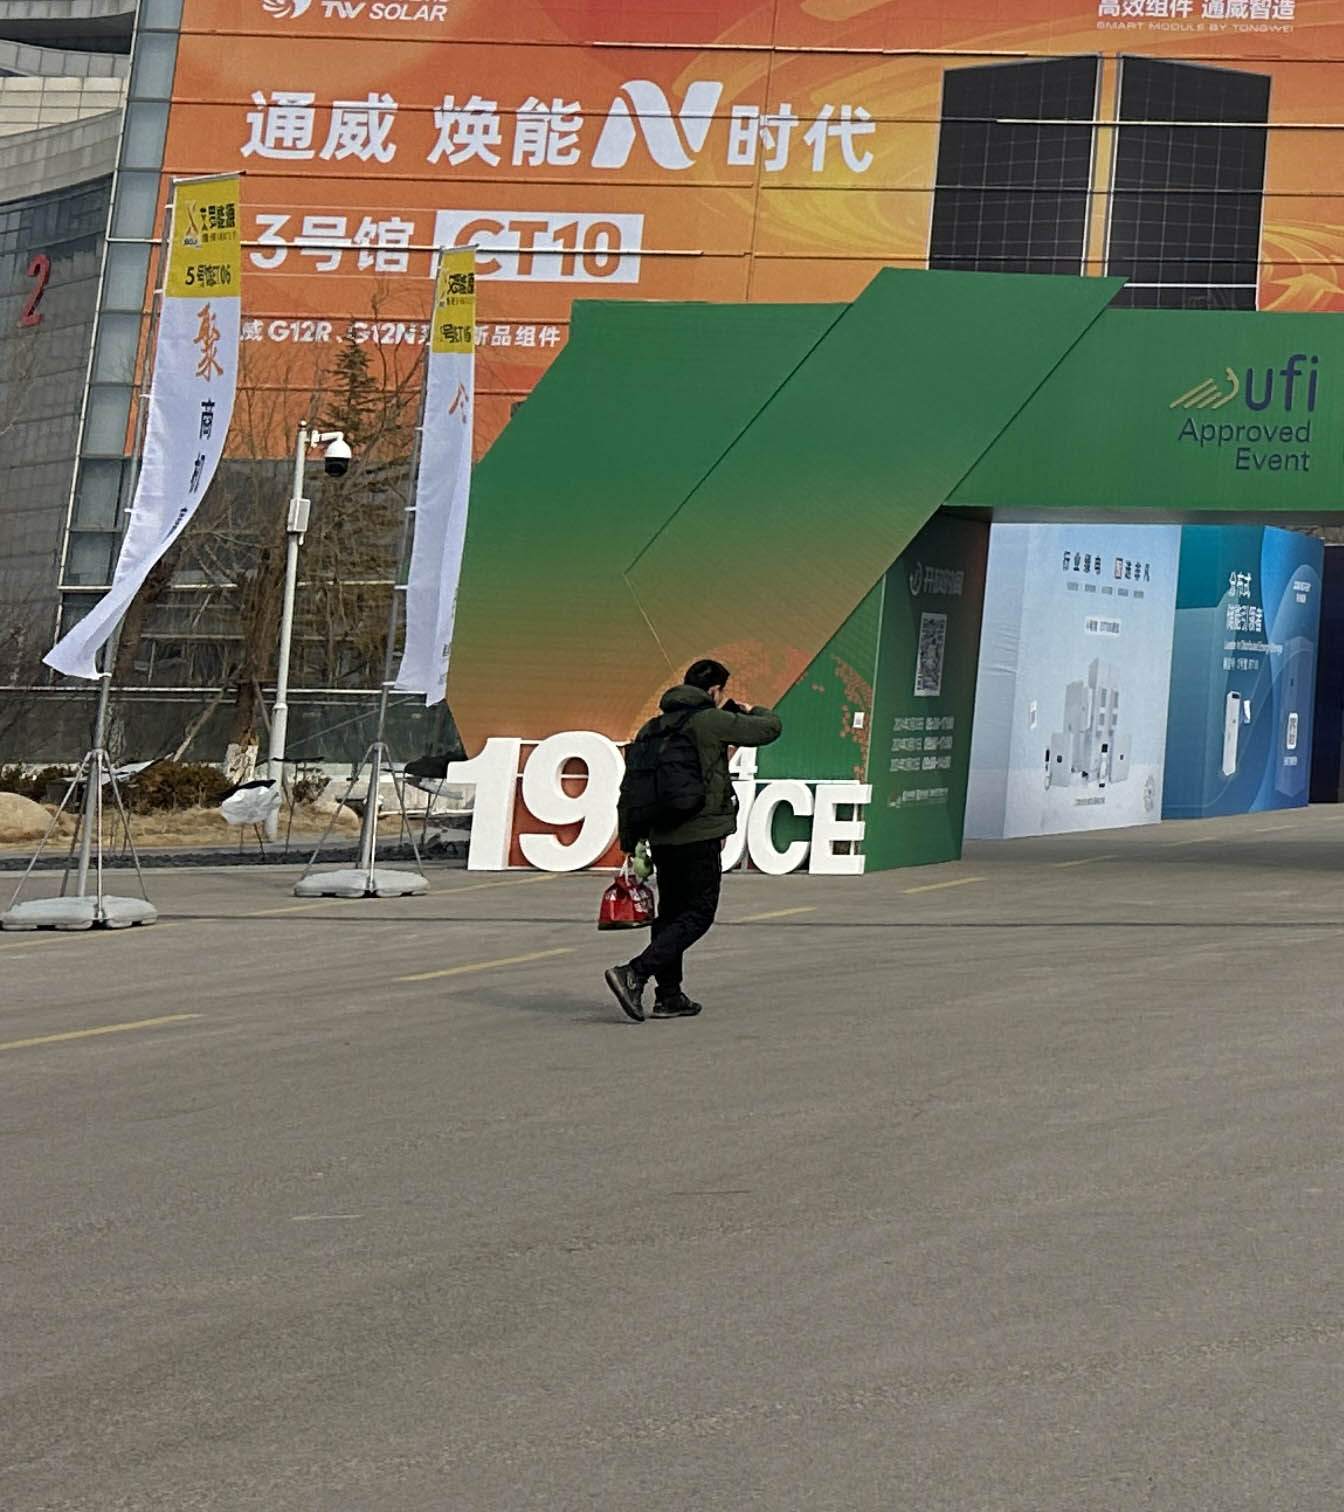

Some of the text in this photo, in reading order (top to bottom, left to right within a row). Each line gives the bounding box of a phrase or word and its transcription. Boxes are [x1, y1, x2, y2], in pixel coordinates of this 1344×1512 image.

[369, 3, 448, 22] SOLAR
[1096, 21, 1295, 34] SMART MODULE BY TONGWEI
[241, 90, 398, 165] 通威
[250, 214, 623, 278] 3号馆 CT10
[16, 253, 50, 327] 2
[1243, 354, 1320, 413] ufi
[1177, 419, 1312, 445] Approved
[1235, 448, 1310, 472] Event
[447, 730, 624, 872] 19
